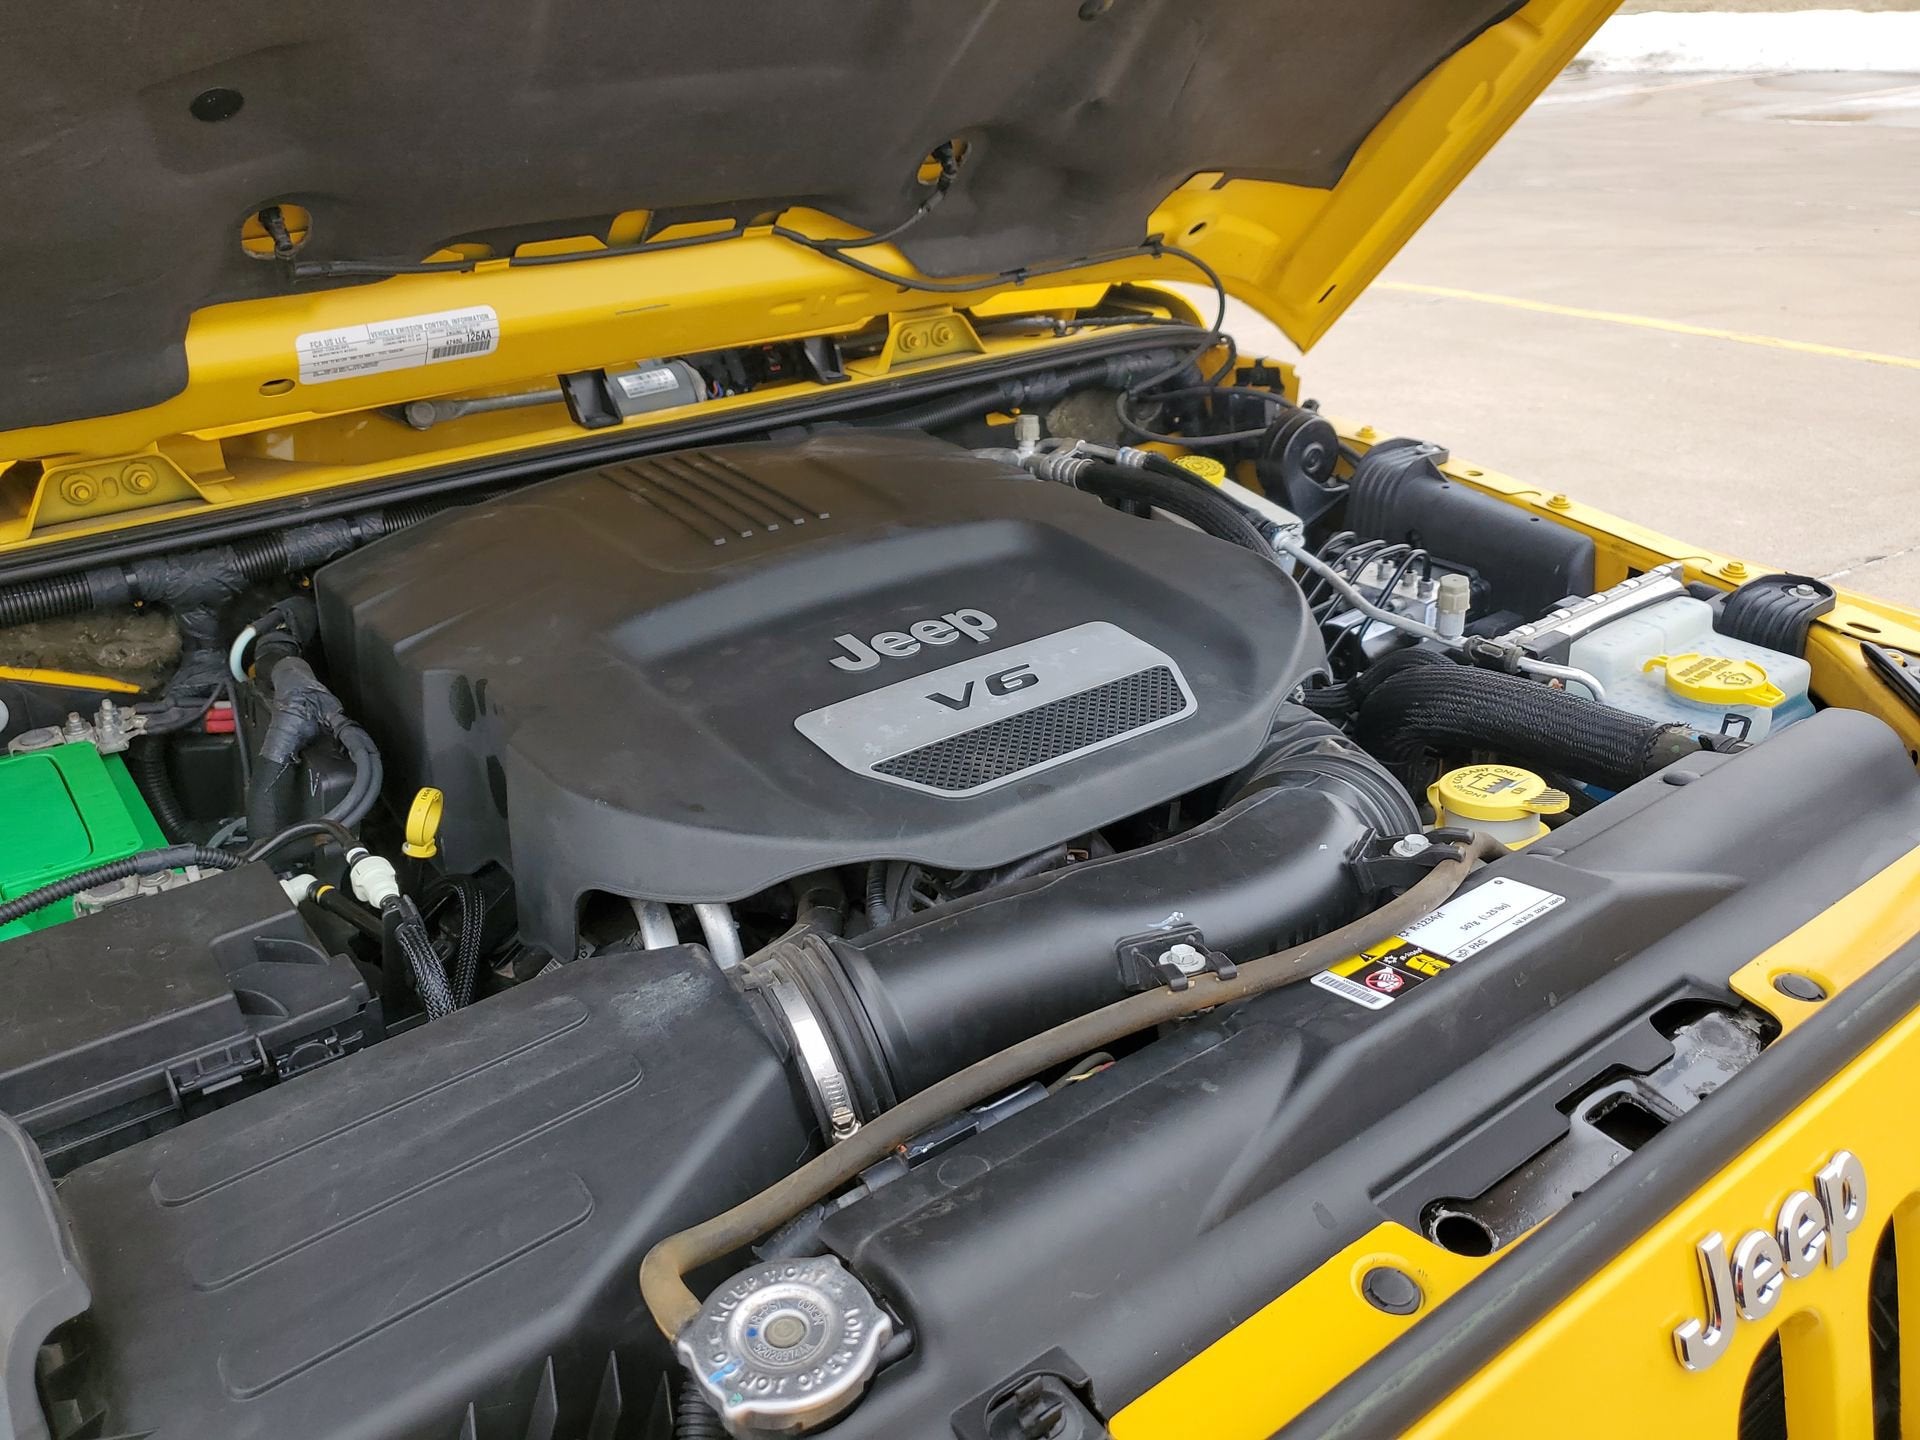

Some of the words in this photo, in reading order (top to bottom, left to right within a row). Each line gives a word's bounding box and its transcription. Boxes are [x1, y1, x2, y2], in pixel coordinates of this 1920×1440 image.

[370, 327, 395, 340] VEHICLE
[396, 322, 424, 336] EMISSION
[424, 318, 450, 331] CONTROL
[451, 312, 490, 327] INFORMATION
[466, 329, 492, 343] 126AA
[309, 340, 323, 349] FCA
[324, 338, 334, 347] US
[335, 336, 347, 345] LLC
[828, 607, 999, 673] Jeep
[924, 663, 1040, 711] V6
[1452, 767, 1489, 784] COOLANT
[1494, 767, 1523, 777] ONLY
[1459, 919, 1481, 931] 567g
[1468, 938, 1488, 950] PAG
[1672, 1149, 1867, 1373] Jeep
[739, 1373, 788, 1394] NOT
[797, 1351, 853, 1391] OPEN
